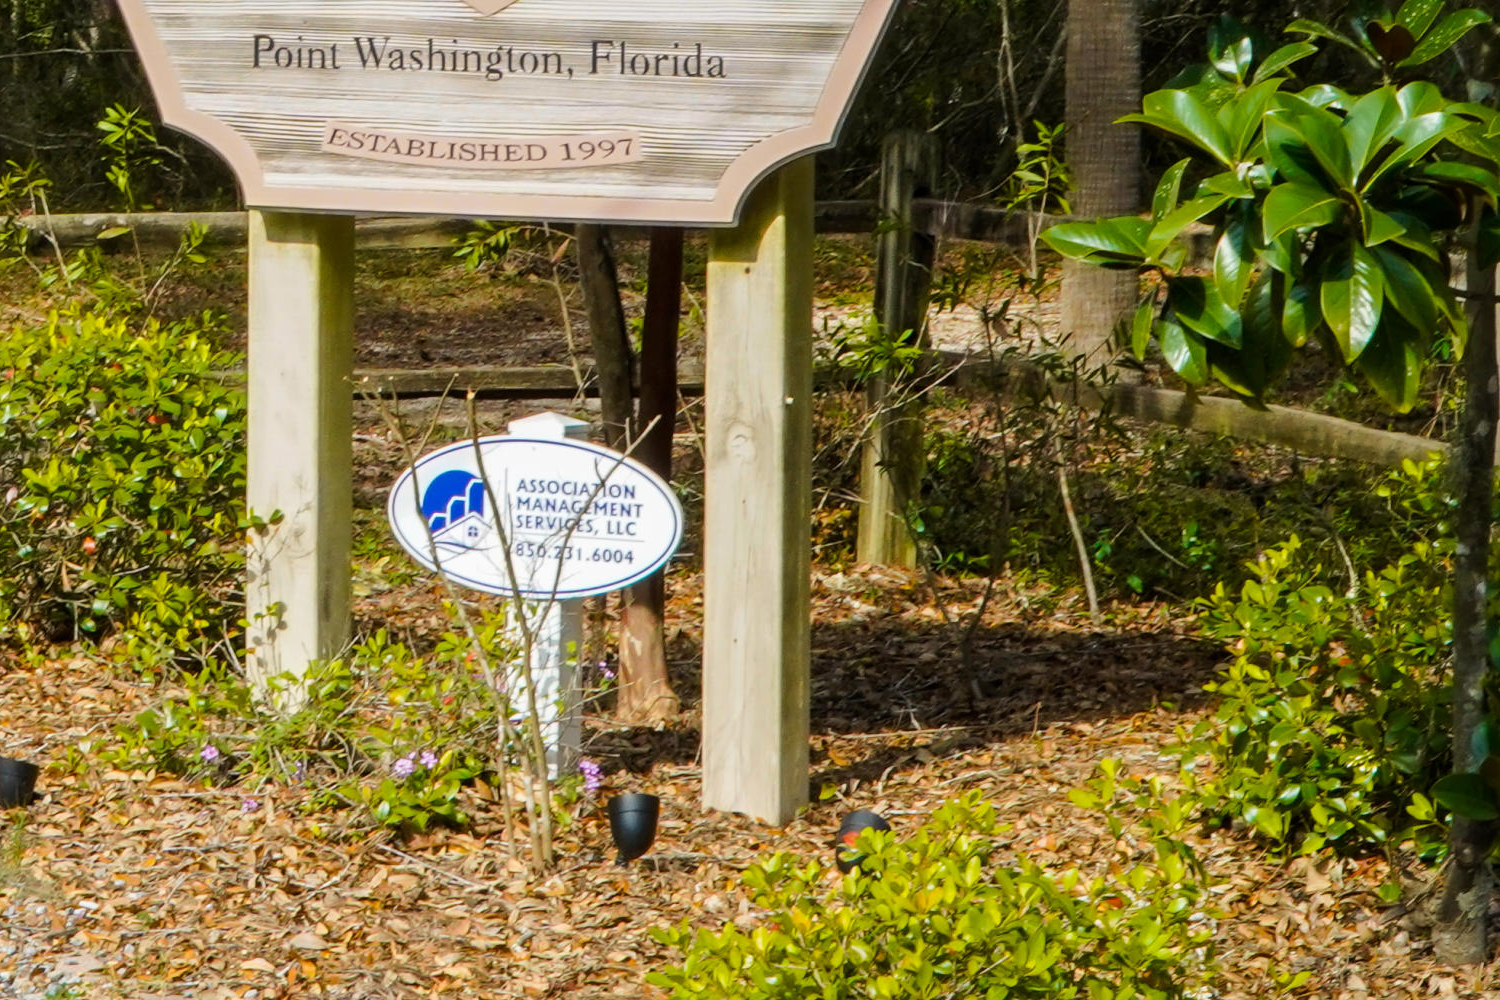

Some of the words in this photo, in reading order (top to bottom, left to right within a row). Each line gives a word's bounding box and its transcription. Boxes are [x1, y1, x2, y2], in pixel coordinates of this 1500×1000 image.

[251, 34, 341, 71] Point
[352, 36, 575, 81] Washington,
[588, 41, 727, 80] Florida
[326, 127, 549, 162] ESTABLISHED
[559, 137, 636, 162] 1997
[517, 479, 636, 499] ASSOCIATION
[516, 515, 598, 536] SERVICES,
[607, 522, 637, 536] LLC
[516, 543, 634, 564] 850.231.6004
